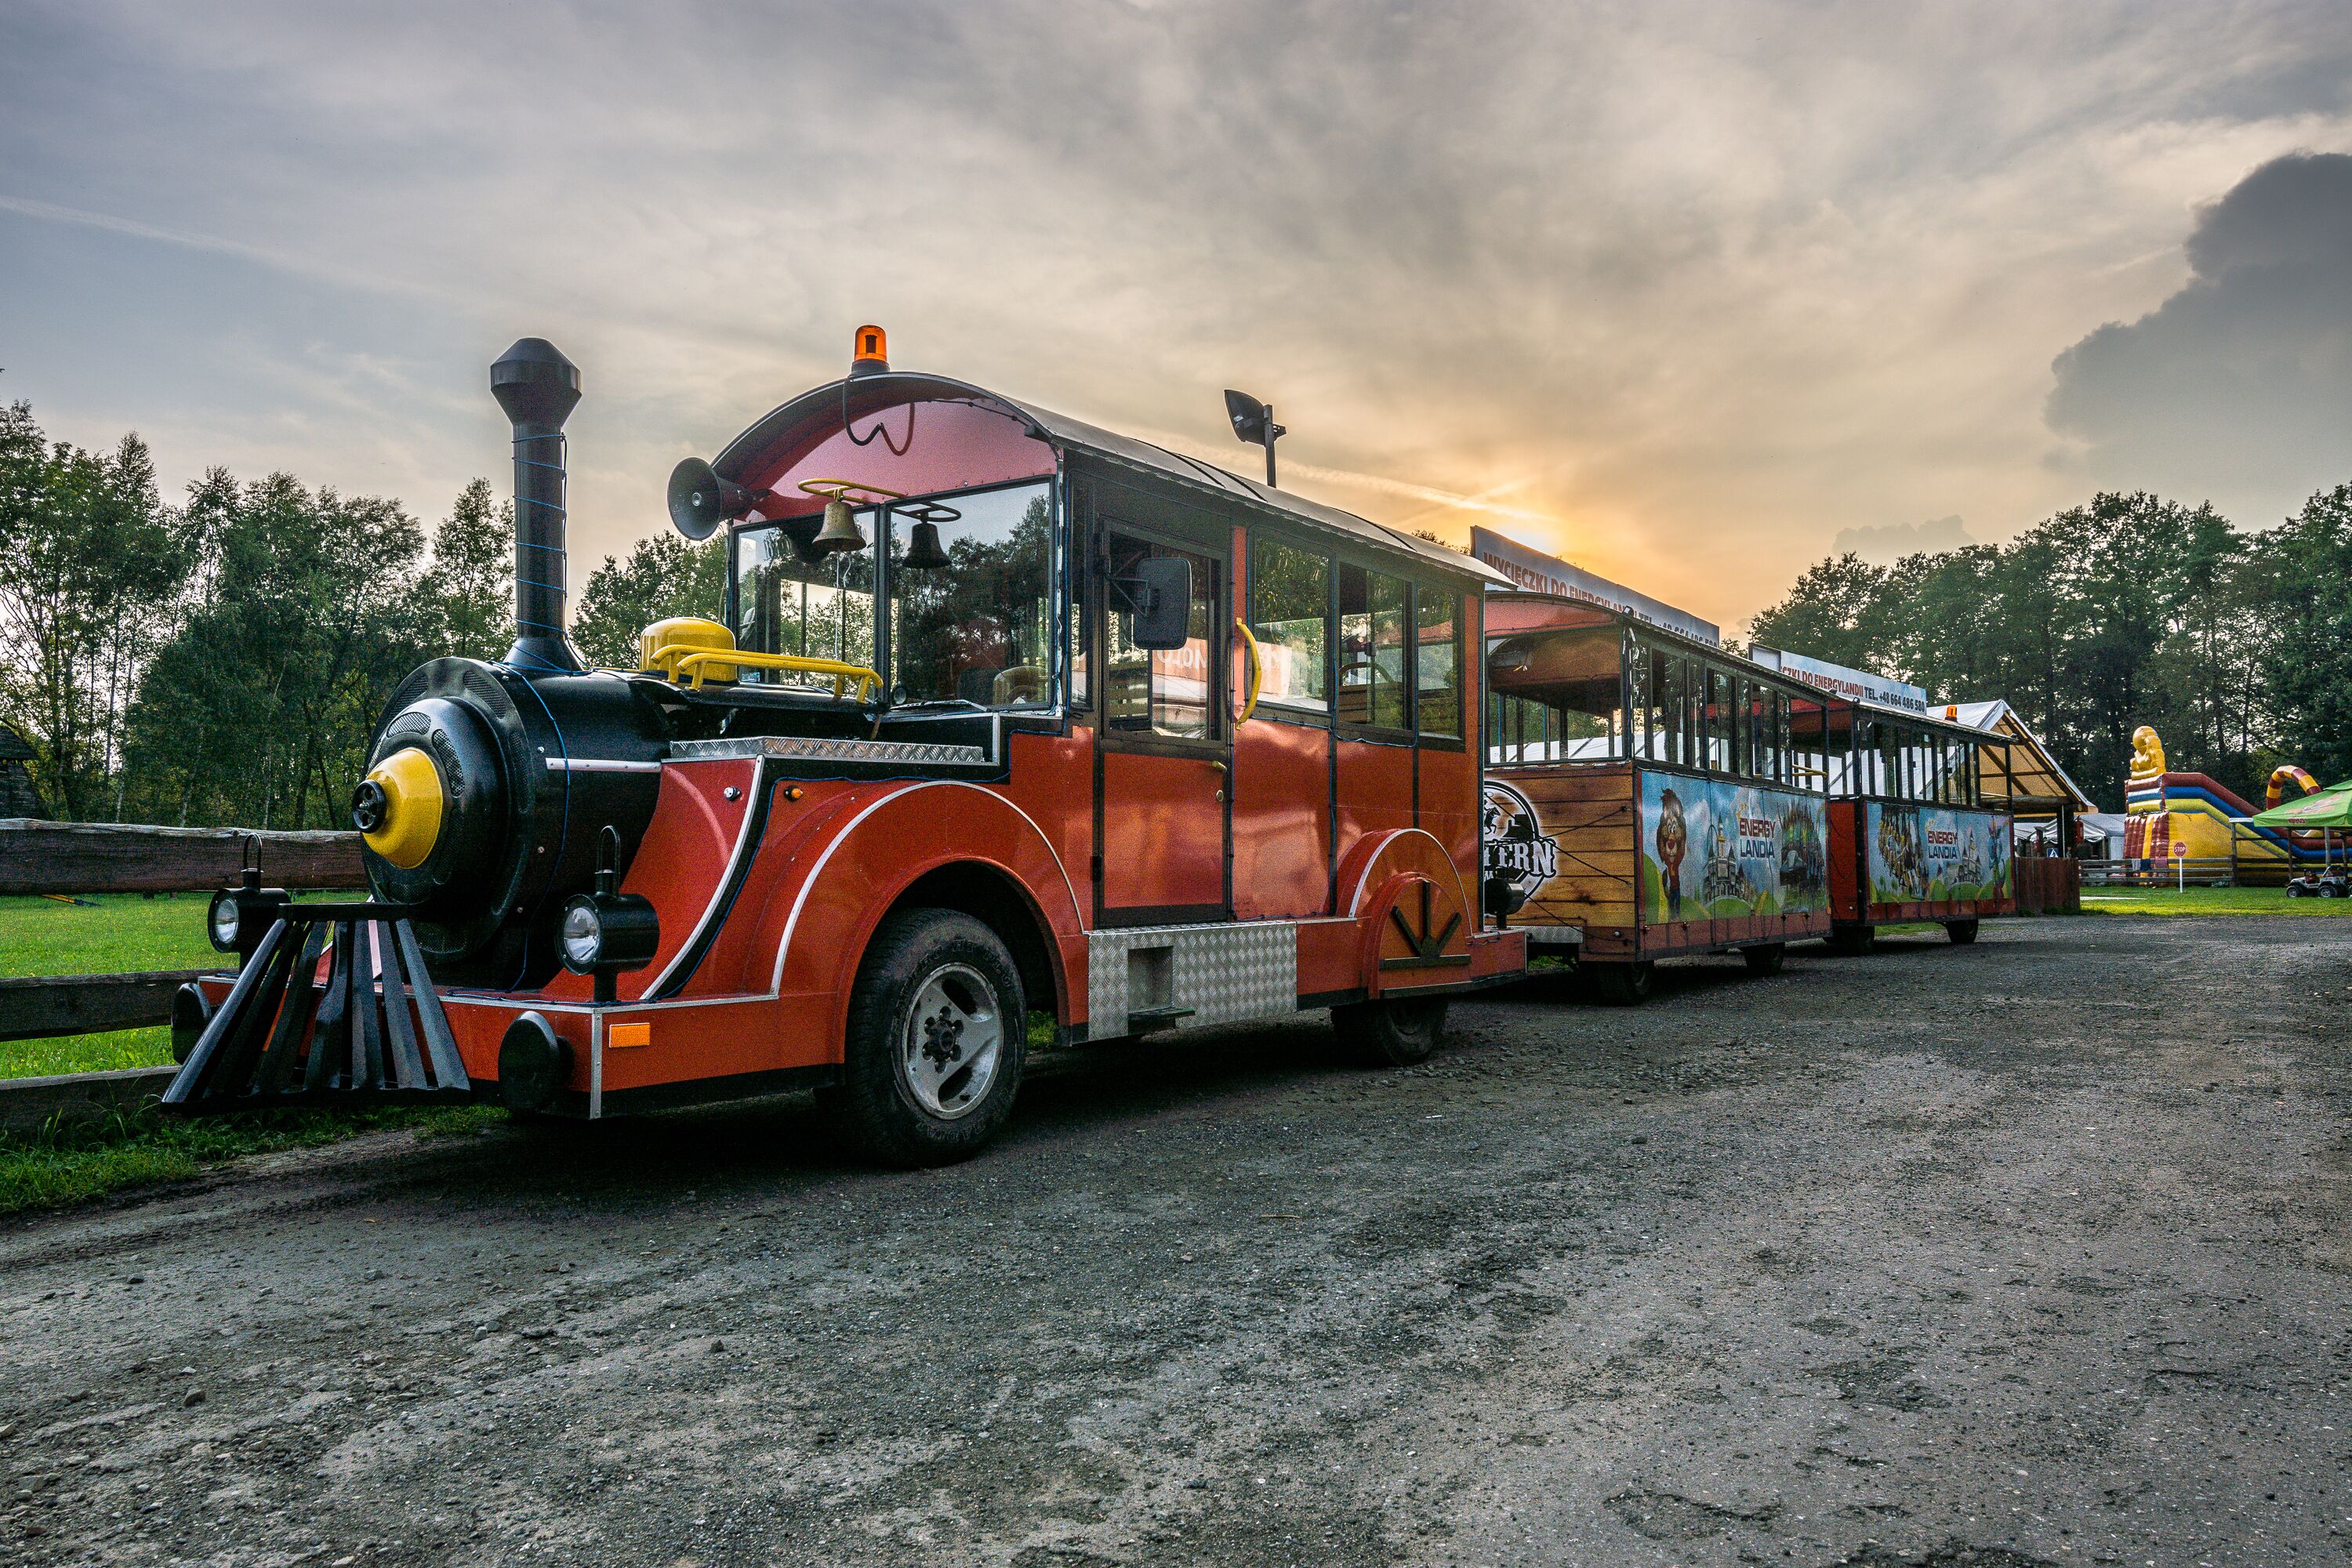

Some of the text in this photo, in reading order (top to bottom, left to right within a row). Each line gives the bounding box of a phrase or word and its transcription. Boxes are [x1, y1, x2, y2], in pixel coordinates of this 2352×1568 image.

[1551, 578, 1567, 597] DO
[1802, 670, 1813, 684] DO
[1814, 673, 1864, 698] ENERGYLANDII
[1864, 686, 1878, 701] TEL.
[1879, 691, 1889, 704] +48
[1890, 693, 1901, 706] 664
[1902, 696, 1914, 710] 486
[1739, 817, 1777, 839] ENERGY
[1927, 829, 1958, 845] ENERGY
[1740, 839, 1776, 858] LANDIA
[1928, 845, 1958, 859] LANDIA
[1483, 840, 1556, 877] TERN
